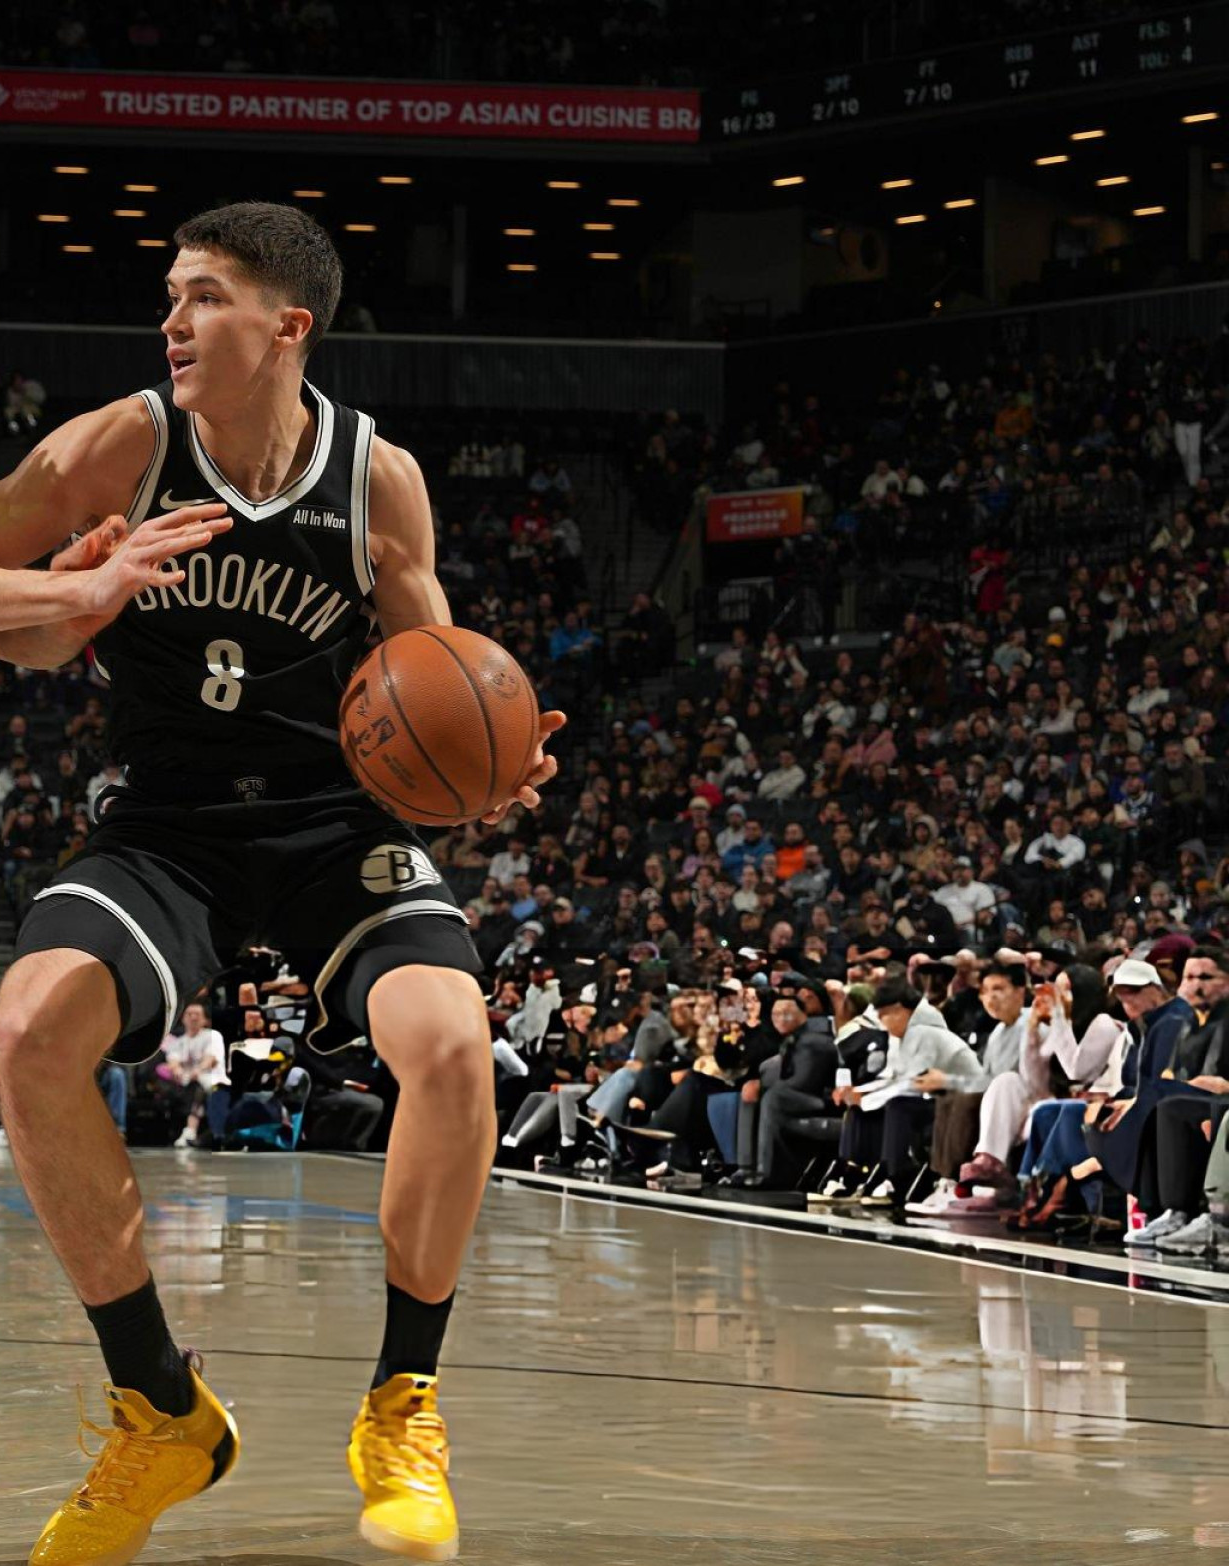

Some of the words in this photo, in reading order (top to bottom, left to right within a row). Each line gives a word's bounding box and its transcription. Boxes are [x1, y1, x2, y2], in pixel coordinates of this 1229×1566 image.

[1009, 69, 1031, 89] 17
[99, 90, 222, 118] TRUSTED
[227, 95, 350, 120] PARTNER
[356, 99, 393, 121] OF
[399, 100, 452, 124] TOP
[459, 102, 540, 127] ASIAN
[547, 106, 652, 130] CUISINE
[293, 509, 309, 525] All
[310, 512, 321, 527] In
[322, 511, 347, 530] Won
[201, 639, 245, 712] 8
[237, 780, 263, 792] NETS
